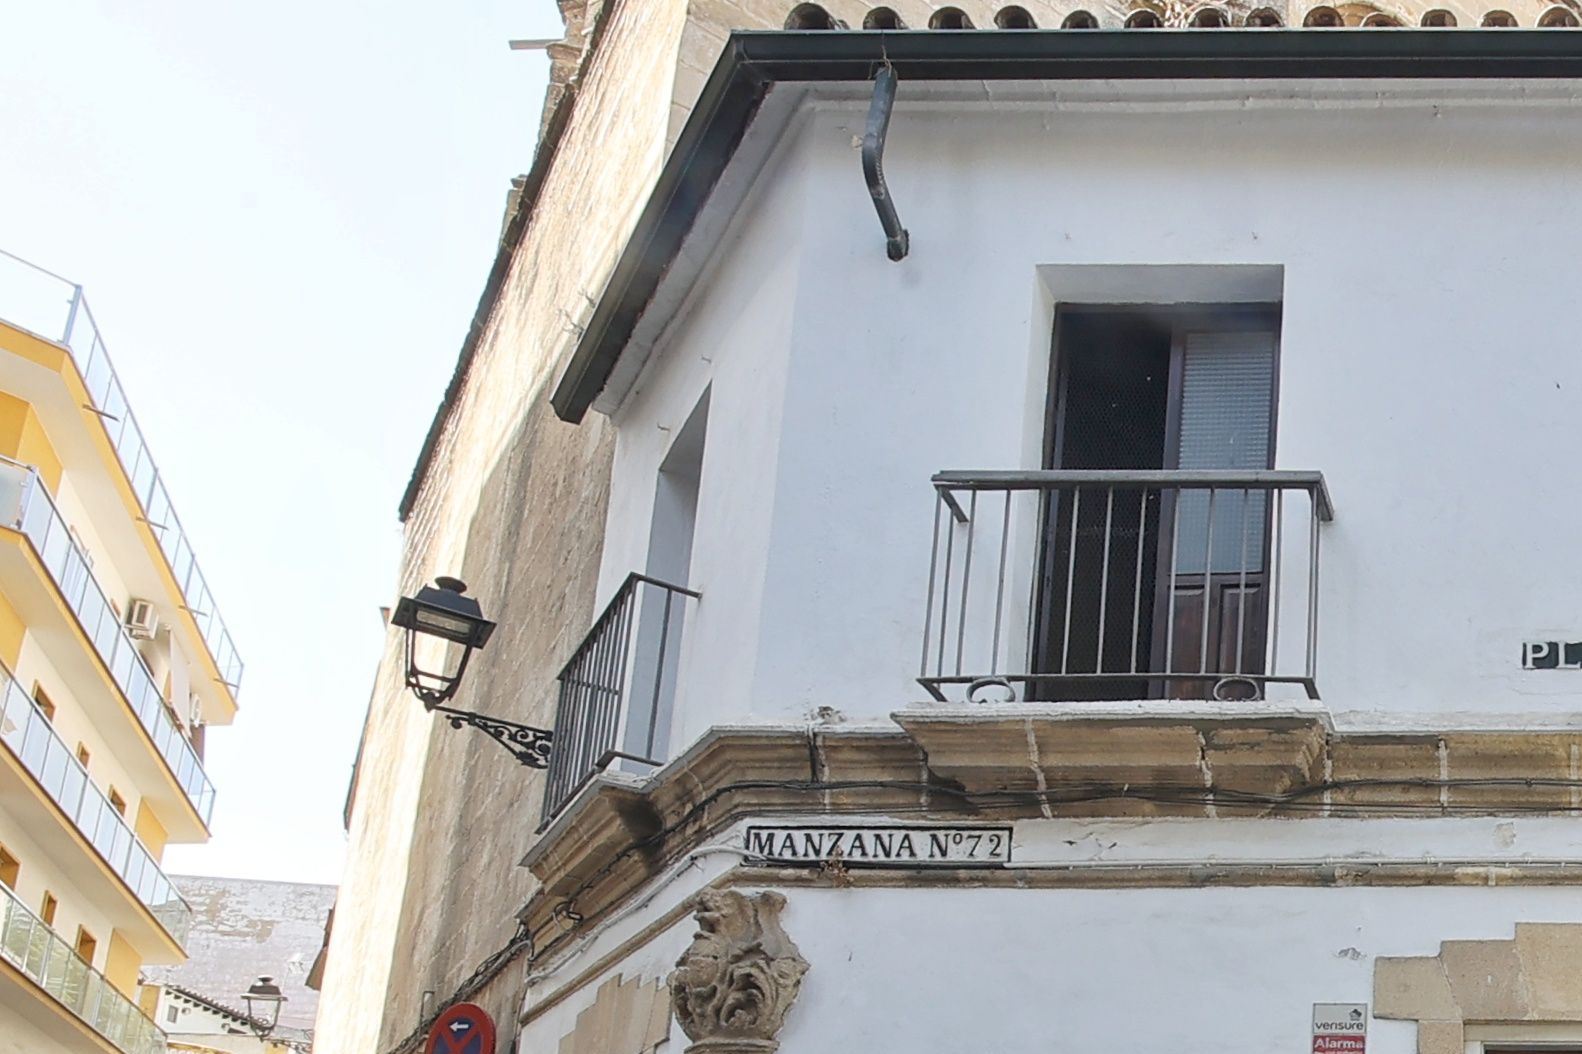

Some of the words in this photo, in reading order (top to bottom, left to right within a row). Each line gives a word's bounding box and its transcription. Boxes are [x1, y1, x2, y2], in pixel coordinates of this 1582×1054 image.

[752, 831, 917, 858] MANZANA
[1315, 1021, 1364, 1031] verisure
[1314, 1038, 1363, 1048] Alarma
